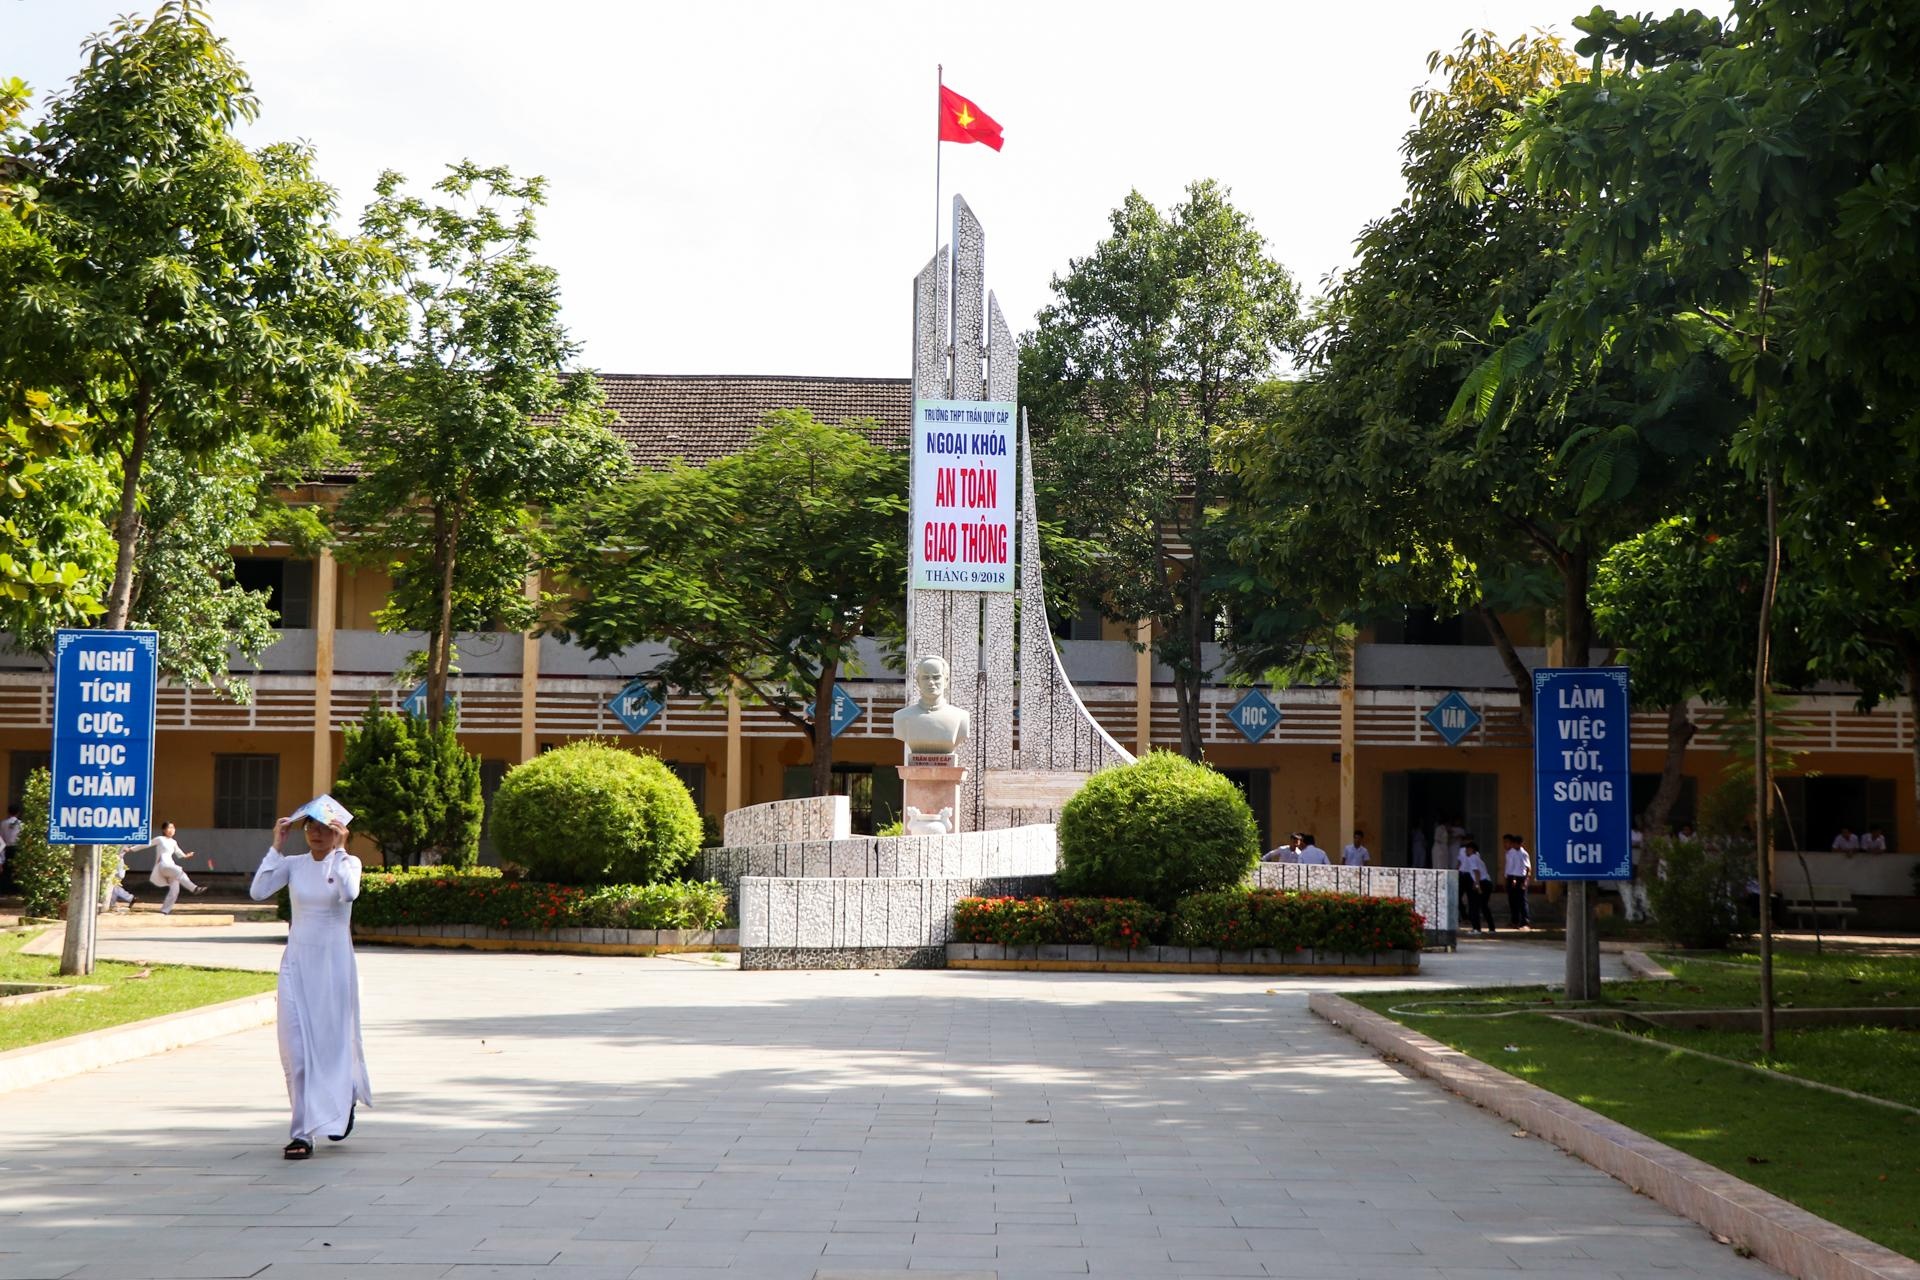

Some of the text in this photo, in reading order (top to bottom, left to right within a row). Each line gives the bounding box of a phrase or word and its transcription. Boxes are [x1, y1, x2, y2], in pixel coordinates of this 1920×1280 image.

[924, 406, 949, 422] TRƯỜNG
[950, 409, 965, 422] THPT
[927, 430, 1007, 460] NGOẠI KHÓA
[935, 460, 997, 509] AN TOÀN
[924, 516, 1007, 565] GIAO THÔNG
[925, 567, 1005, 584] THÁNG 9/2018
[78, 647, 136, 672] NGHĨ
[79, 677, 131, 703] TÍCH
[1558, 684, 1605, 709] LÀM
[77, 711, 131, 738] CỰC,
[1241, 706, 1267, 729] HỌC
[1441, 706, 1466, 729] VĂN
[1557, 715, 1606, 743] VIỆC
[79, 744, 127, 770] HỌC
[1560, 743, 1603, 773] TỐT,
[67, 771, 136, 797] CHĂM
[1553, 775, 1613, 802] SỐNG
[60, 806, 140, 829] NGOAN
[1569, 808, 1598, 833] CÓ
[1565, 839, 1602, 864] ÍCH
